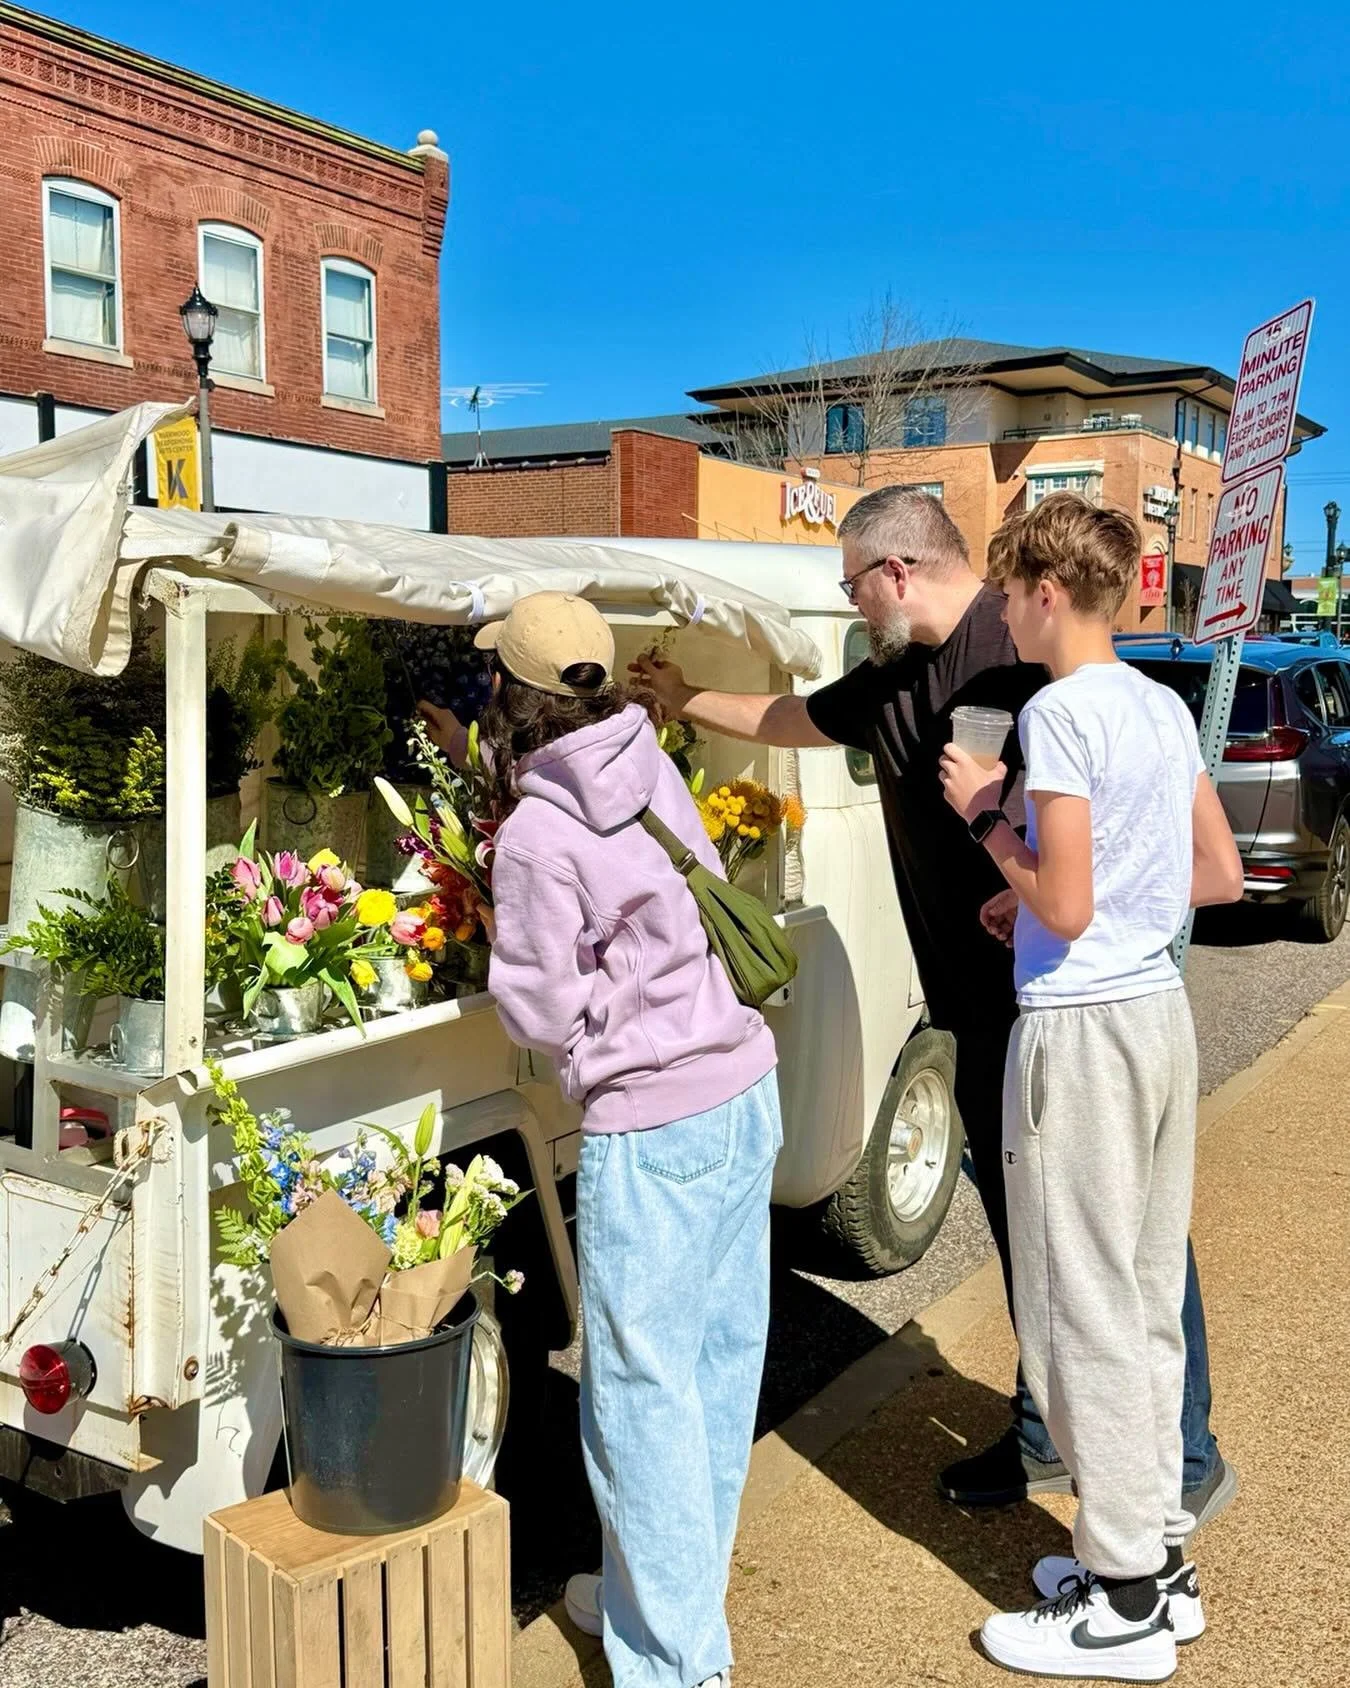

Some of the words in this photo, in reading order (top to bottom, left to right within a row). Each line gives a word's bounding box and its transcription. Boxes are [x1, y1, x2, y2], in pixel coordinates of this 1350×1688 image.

[1243, 330, 1303, 377] MINUTE
[1240, 355, 1297, 399] PARKING
[1231, 422, 1256, 445] EXCEPT
[1257, 405, 1288, 432] SUNDAYS
[1241, 407, 1254, 424] AM
[1257, 400, 1267, 416] TO
[1271, 395, 1278, 409] 7
[1277, 388, 1290, 406] PM
[1227, 444, 1245, 463] AND
[1246, 424, 1286, 453] HOLIDAYS
[166, 459, 188, 500] K
[1232, 488, 1257, 523] NO
[1211, 516, 1268, 565] PARKING
[1220, 554, 1247, 583] ANY
[1215, 578, 1244, 606] TIME
